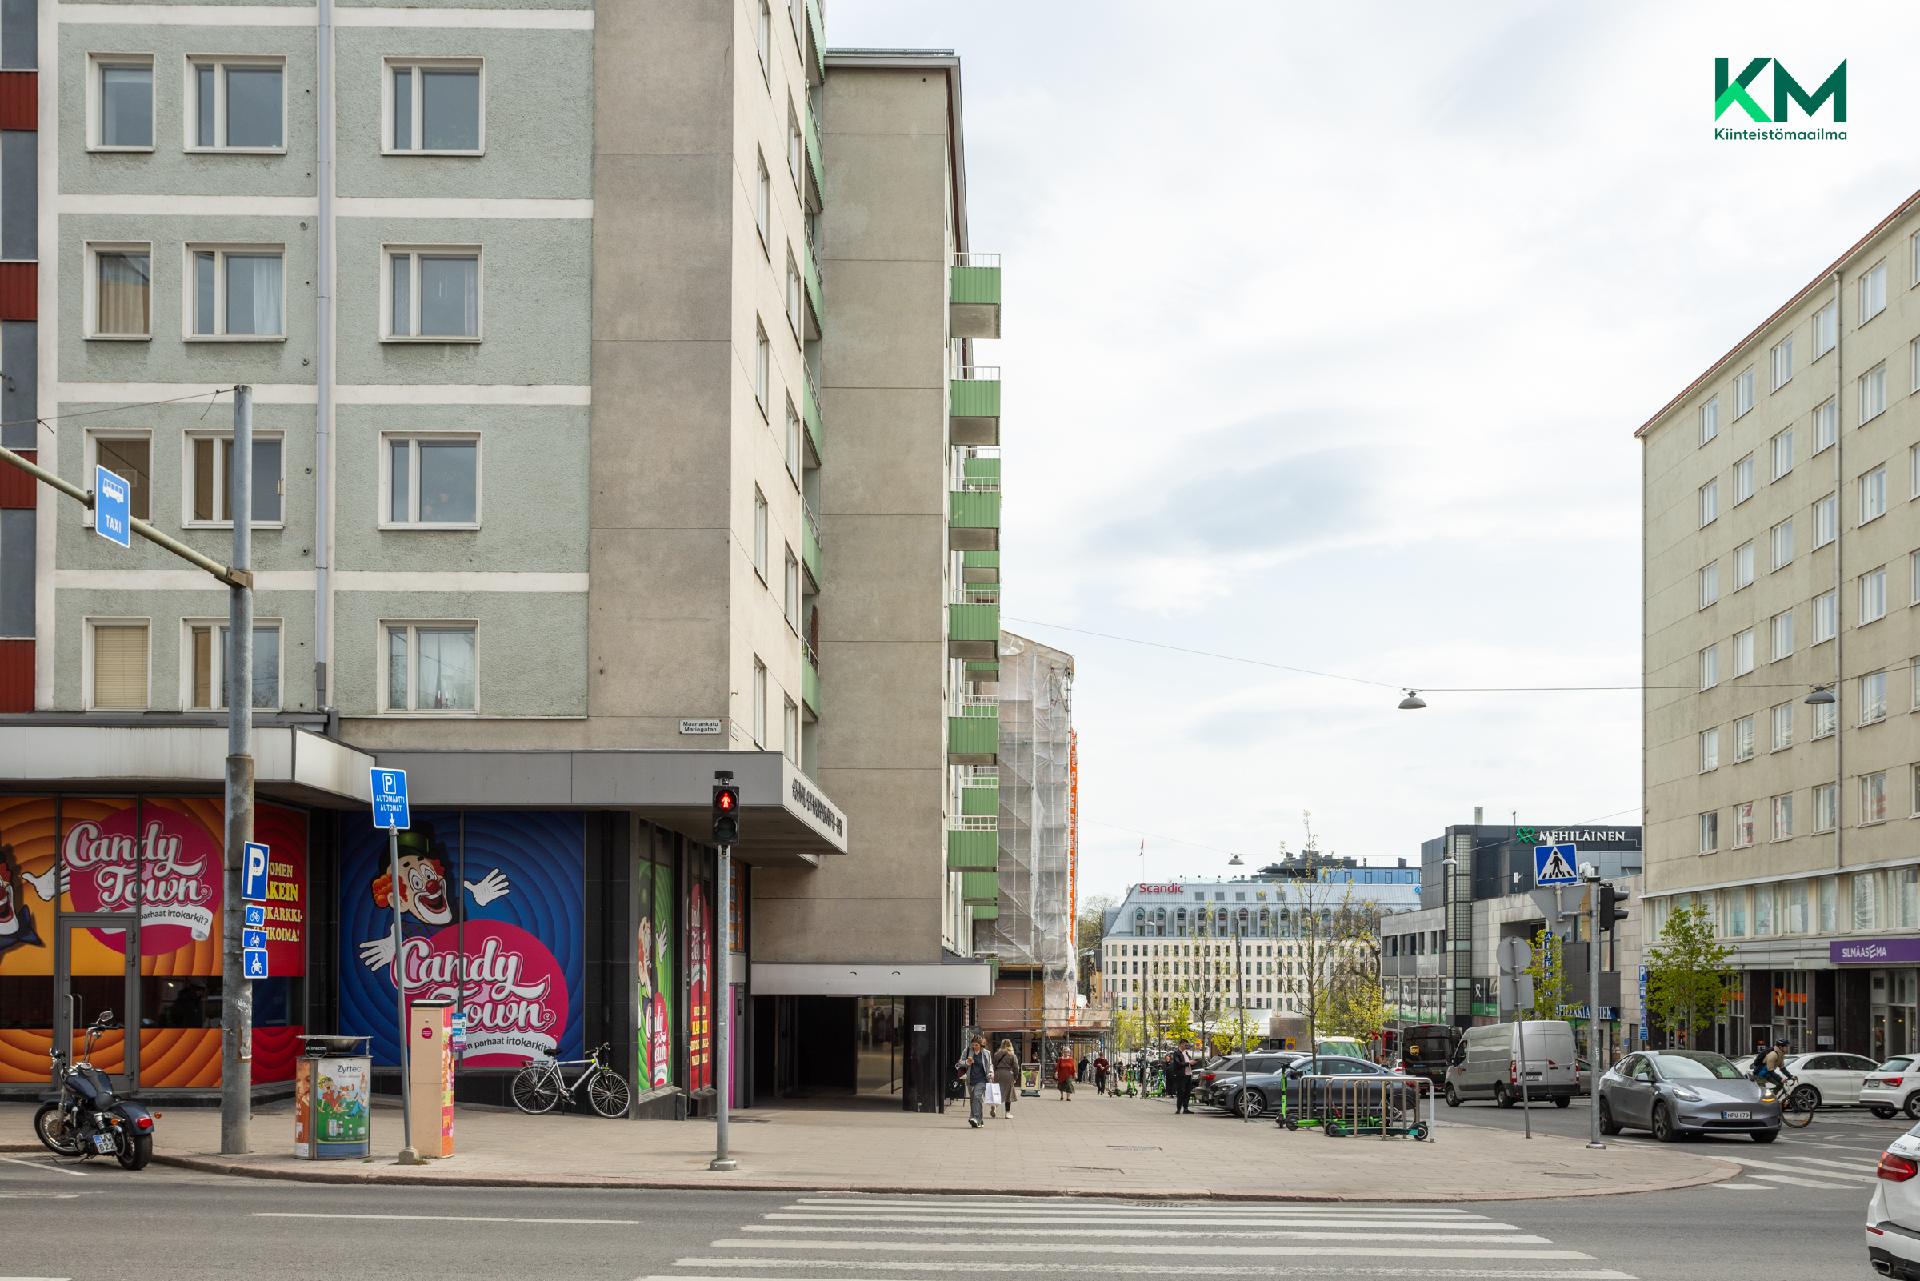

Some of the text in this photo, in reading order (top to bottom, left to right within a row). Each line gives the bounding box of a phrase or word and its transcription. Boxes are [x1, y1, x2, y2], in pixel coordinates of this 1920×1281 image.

[105, 513, 122, 534] TAXI
[384, 775, 393, 792] P
[375, 794, 406, 804] AUTOMAATTI
[380, 803, 402, 812] AUTOMAT
[1539, 829, 1626, 842] MEHILÄINEN
[63, 821, 205, 878] Candy
[246, 847, 266, 896] P
[97, 864, 204, 903] Town
[1139, 882, 1185, 894] Scandic
[1841, 944, 1887, 959] SILMÄASEMA
[391, 937, 549, 1000] Candy
[474, 1037, 505, 1050] parhaat
[337, 1064, 362, 1074] Zyrtec
